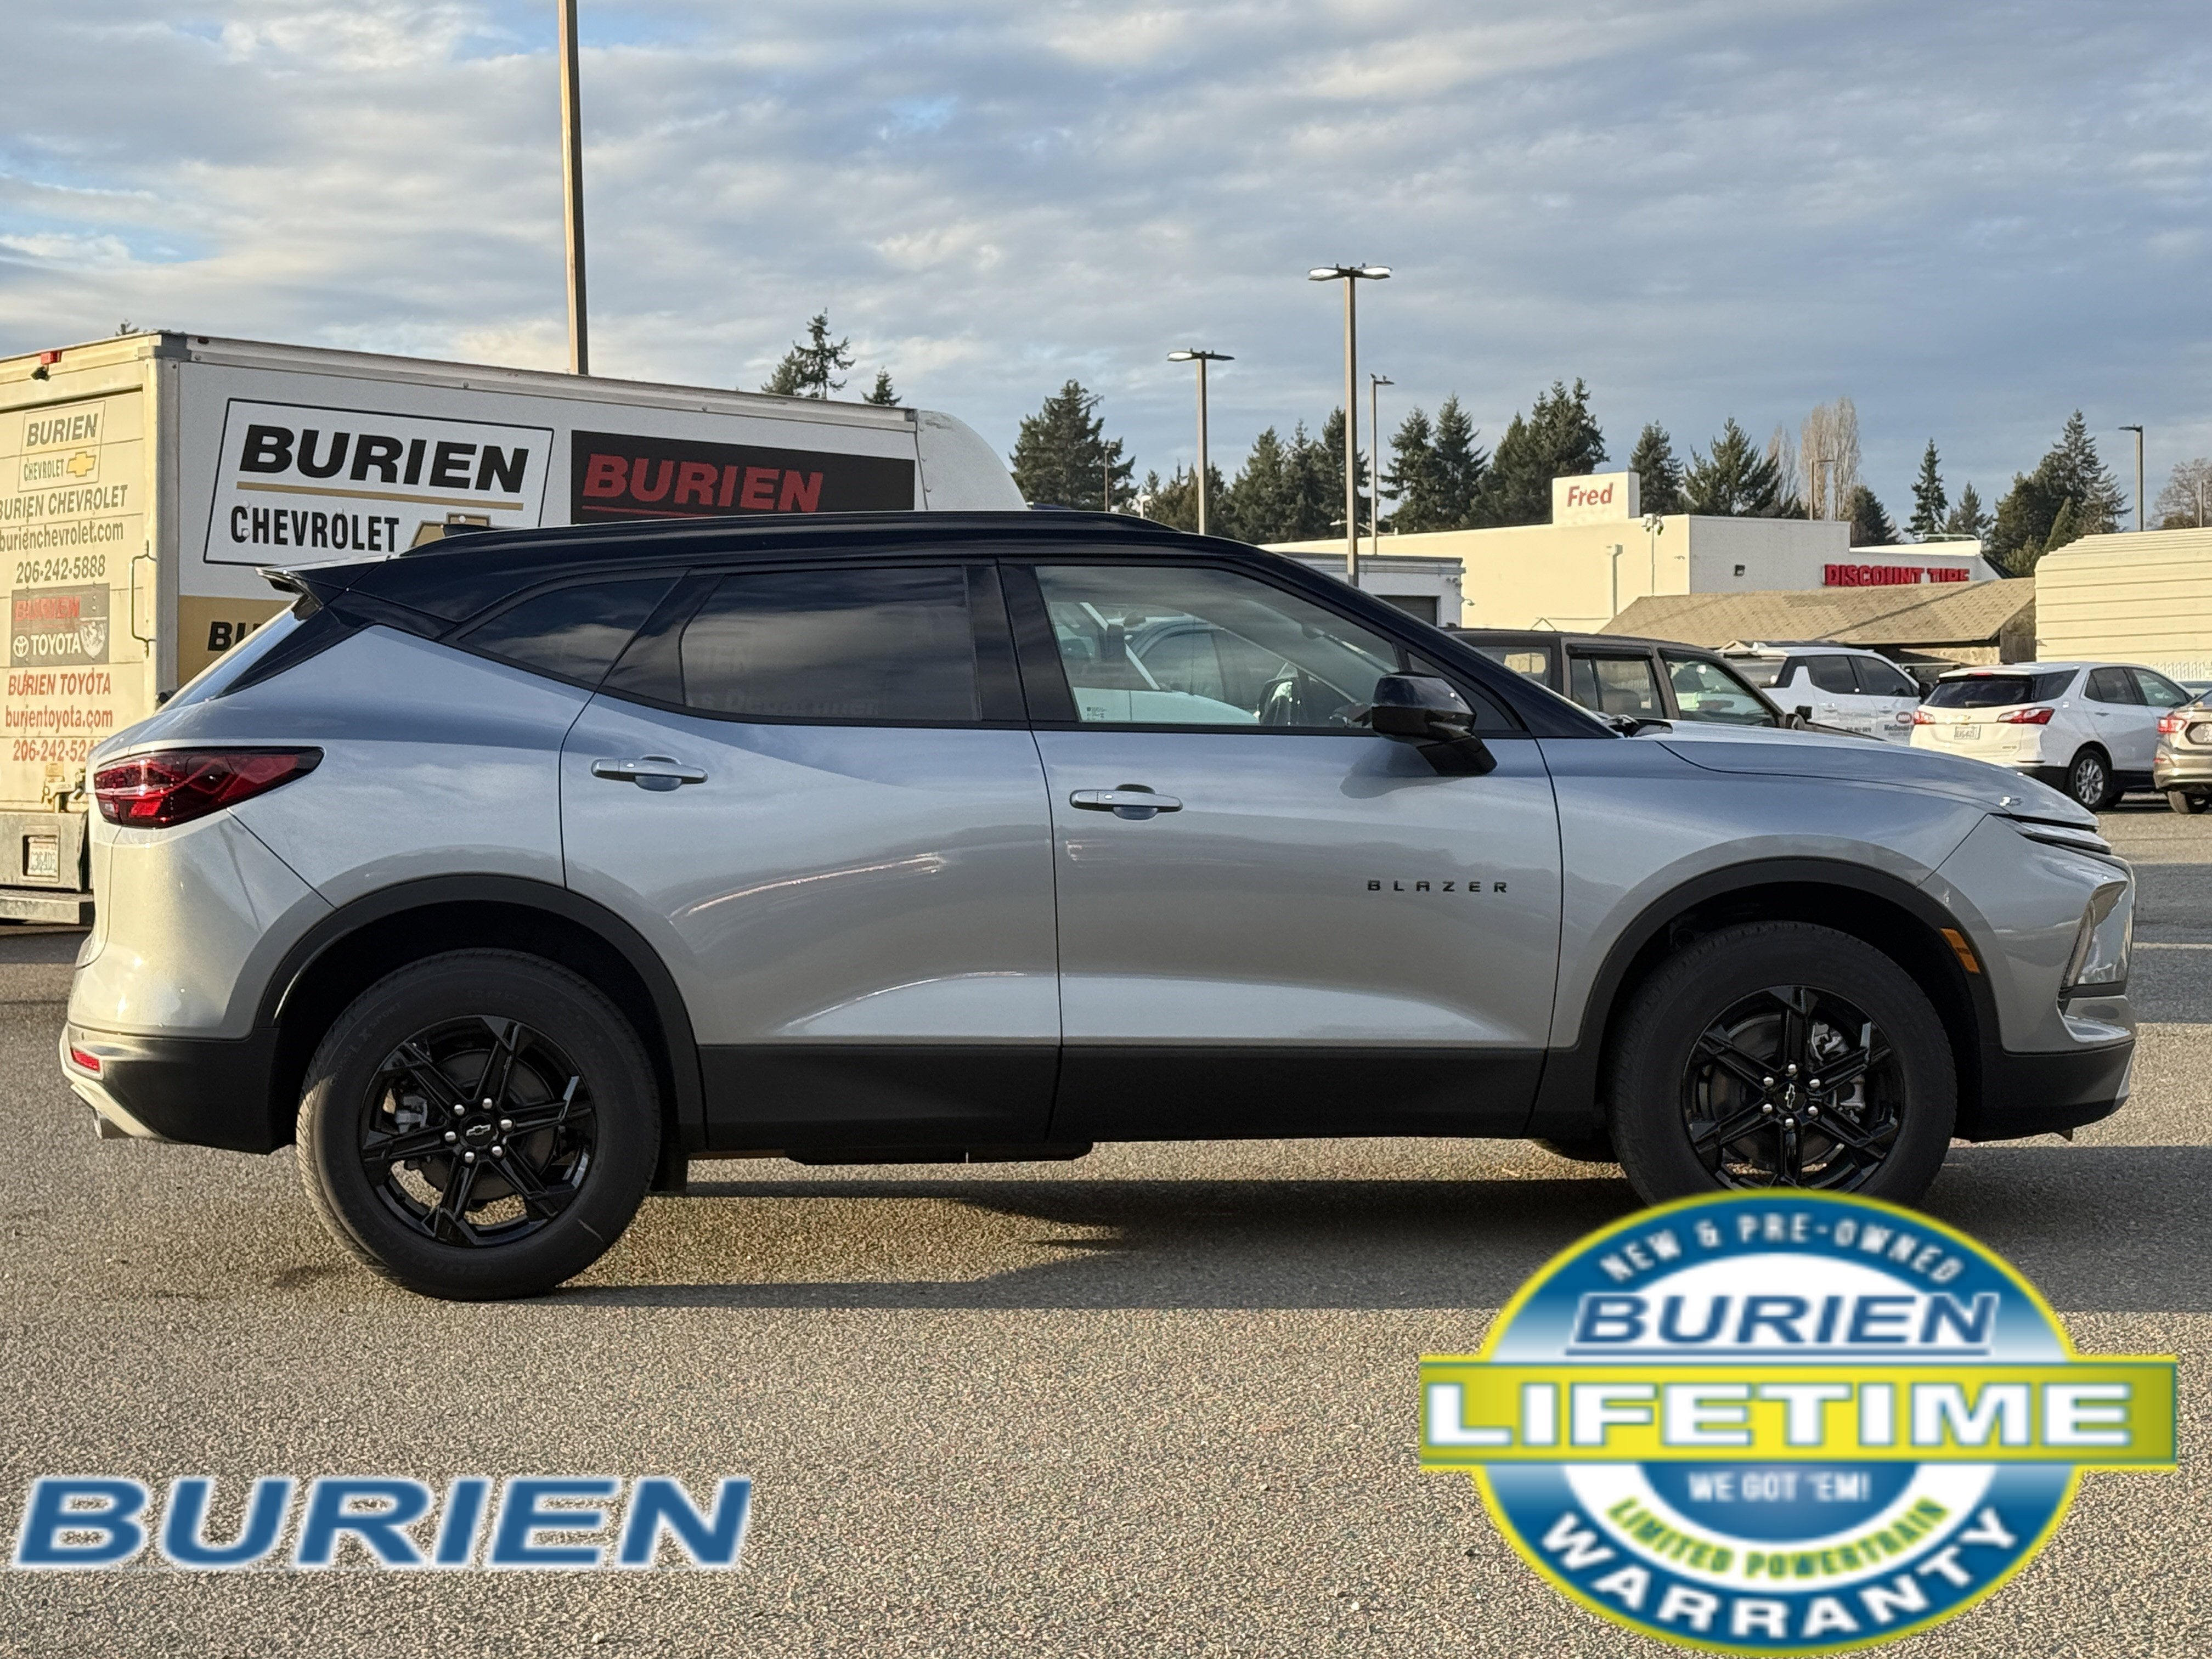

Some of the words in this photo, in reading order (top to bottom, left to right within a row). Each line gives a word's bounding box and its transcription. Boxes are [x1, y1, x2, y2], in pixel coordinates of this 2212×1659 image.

[26, 413, 98, 447] BURIEN
[24, 458, 64, 481] CHEVROLET
[239, 424, 529, 493] BURIEN
[583, 454, 823, 512] BURIEN
[1567, 482, 1613, 507] Fred
[48, 484, 128, 515] CHEVROLET
[0, 521, 123, 552] burienchevrolet.com
[231, 506, 399, 552] CHEVROLET
[1824, 563, 1925, 586] DISCOUNT
[15, 596, 81, 622] BURIEN
[31, 633, 82, 656] TOYOTA
[8, 673, 56, 696] BURIEN
[60, 672, 111, 696] TOYOTA
[5, 705, 113, 733] burientoyota.com
[1367, 879, 1507, 893] BLAZER
